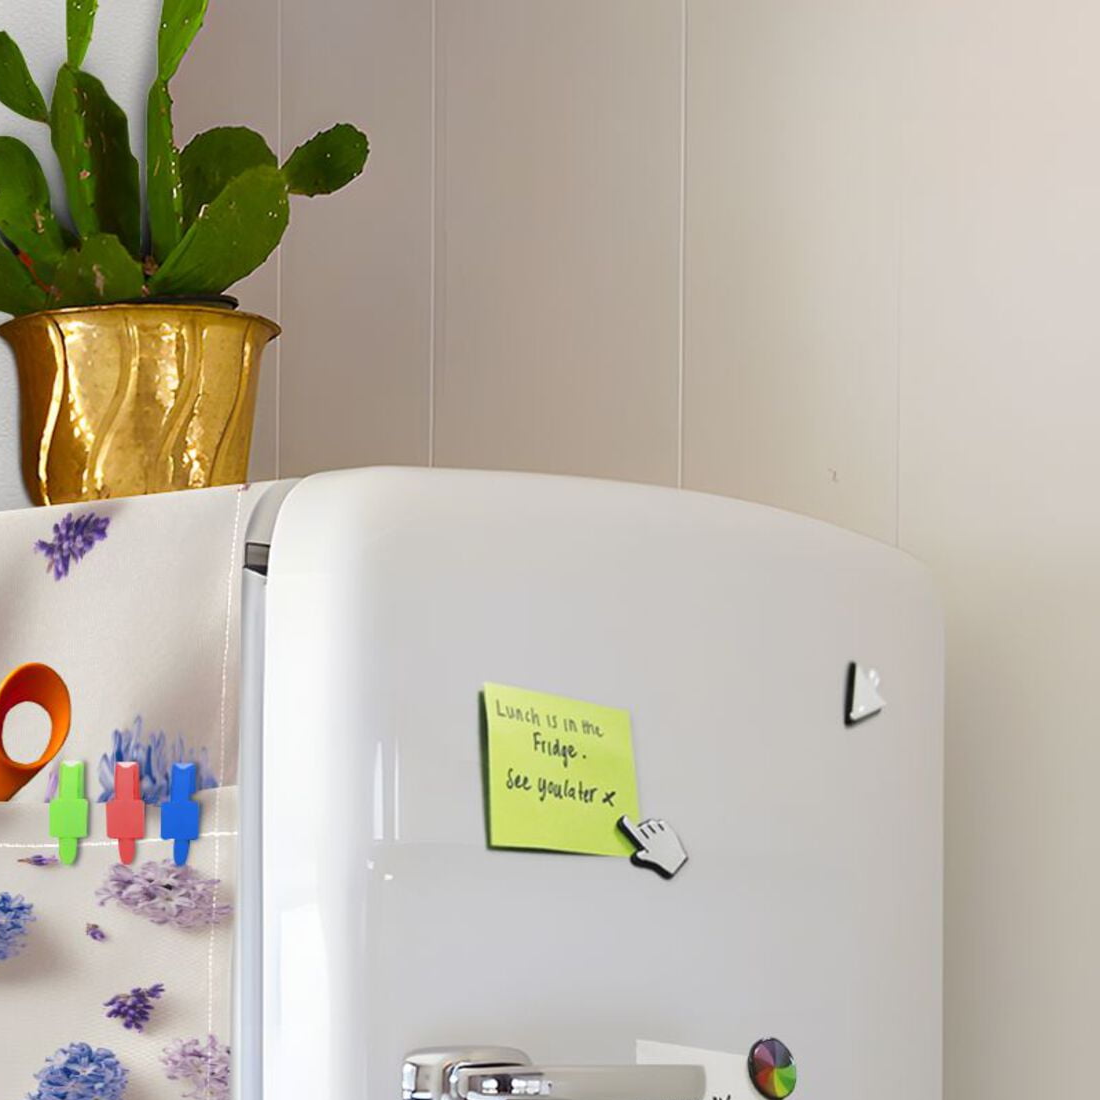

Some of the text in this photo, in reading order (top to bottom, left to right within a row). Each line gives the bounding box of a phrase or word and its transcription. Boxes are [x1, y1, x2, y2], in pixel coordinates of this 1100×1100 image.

[495, 699, 604, 738] Lunch is in the
[506, 768, 532, 790] See
